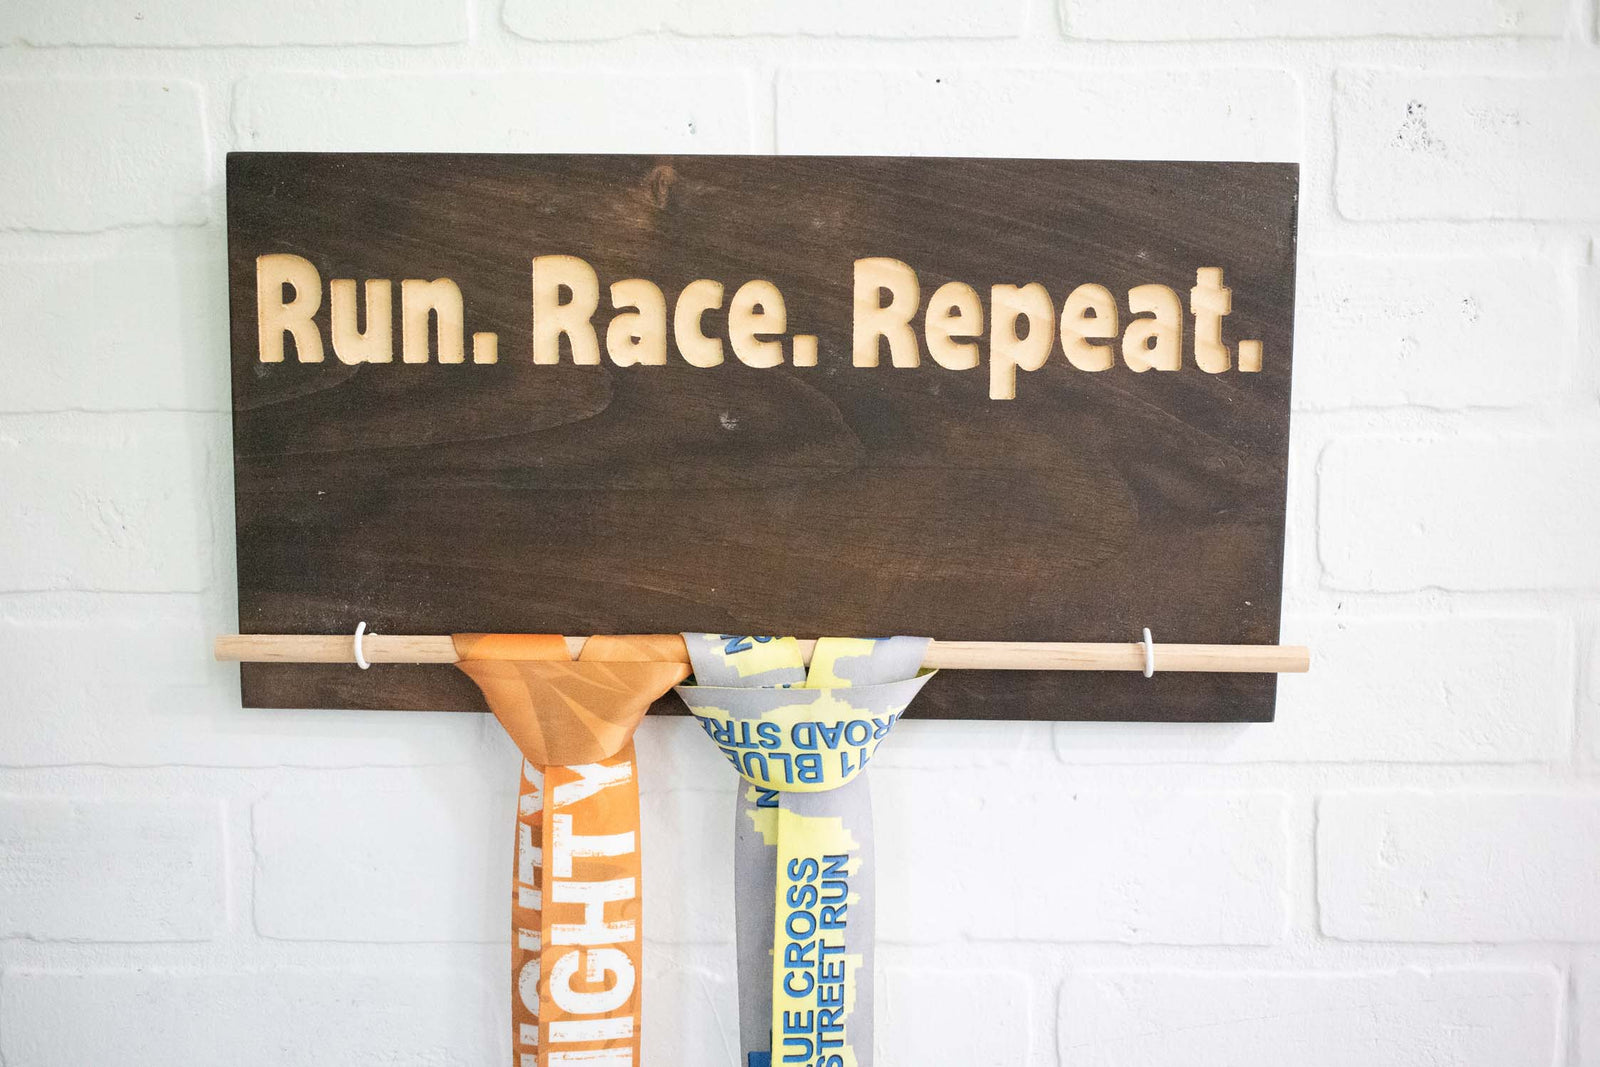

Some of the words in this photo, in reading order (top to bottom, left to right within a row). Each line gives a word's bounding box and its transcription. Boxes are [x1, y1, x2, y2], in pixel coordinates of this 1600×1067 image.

[256, 254, 498, 365] Run.
[532, 254, 818, 368] Race.
[853, 257, 1263, 400] Repeat.
[791, 711, 905, 750] ROAD
[548, 761, 635, 1067] IGHTY
[783, 857, 820, 998] CROSS
[820, 854, 849, 930] RUN
[782, 1009, 816, 1067] UE
